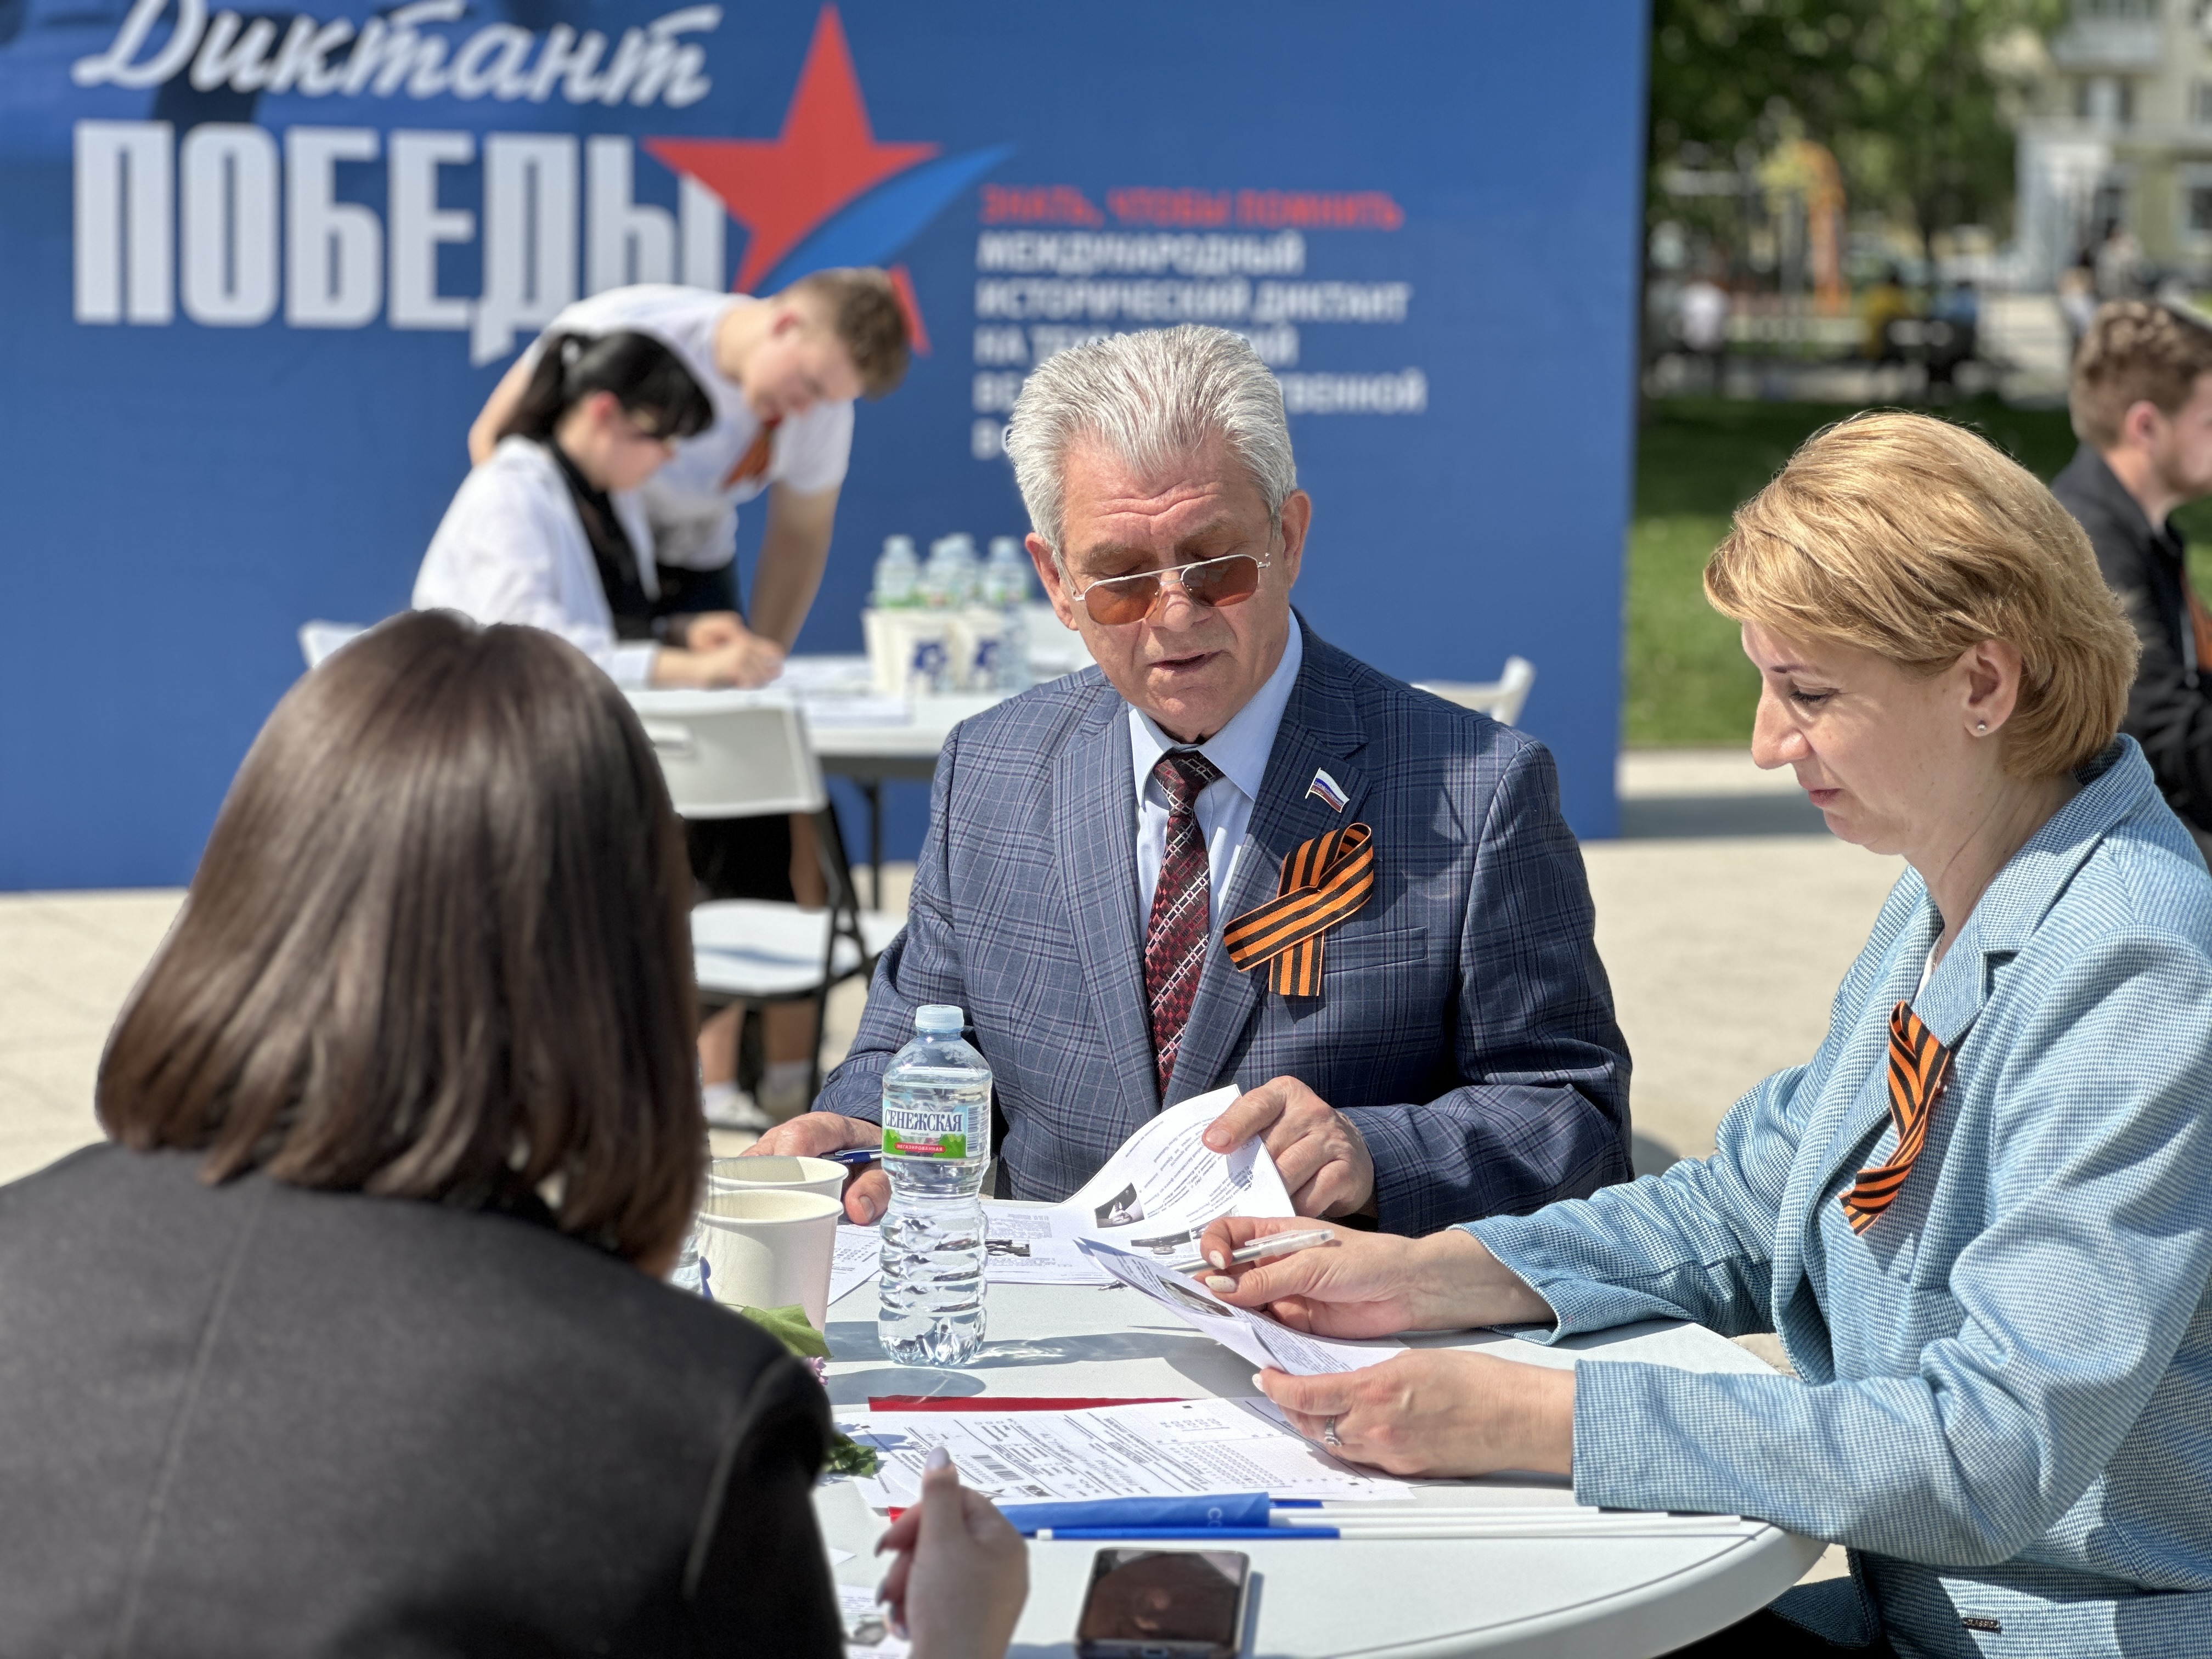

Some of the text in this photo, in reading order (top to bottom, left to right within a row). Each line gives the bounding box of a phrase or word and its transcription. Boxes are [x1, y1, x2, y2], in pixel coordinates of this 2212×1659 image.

[70, 0, 722, 106] Диктант
[73, 119, 726, 366] ПОБЕДЫ
[978, 230, 1304, 275] МЕЖДУНАРОДНЫЙ
[976, 278, 1411, 322] ИСТОРИЧЕСКИЙ ДИКТАНТ
[885, 1109, 963, 1132] СЕНЕЖСКАЯ
